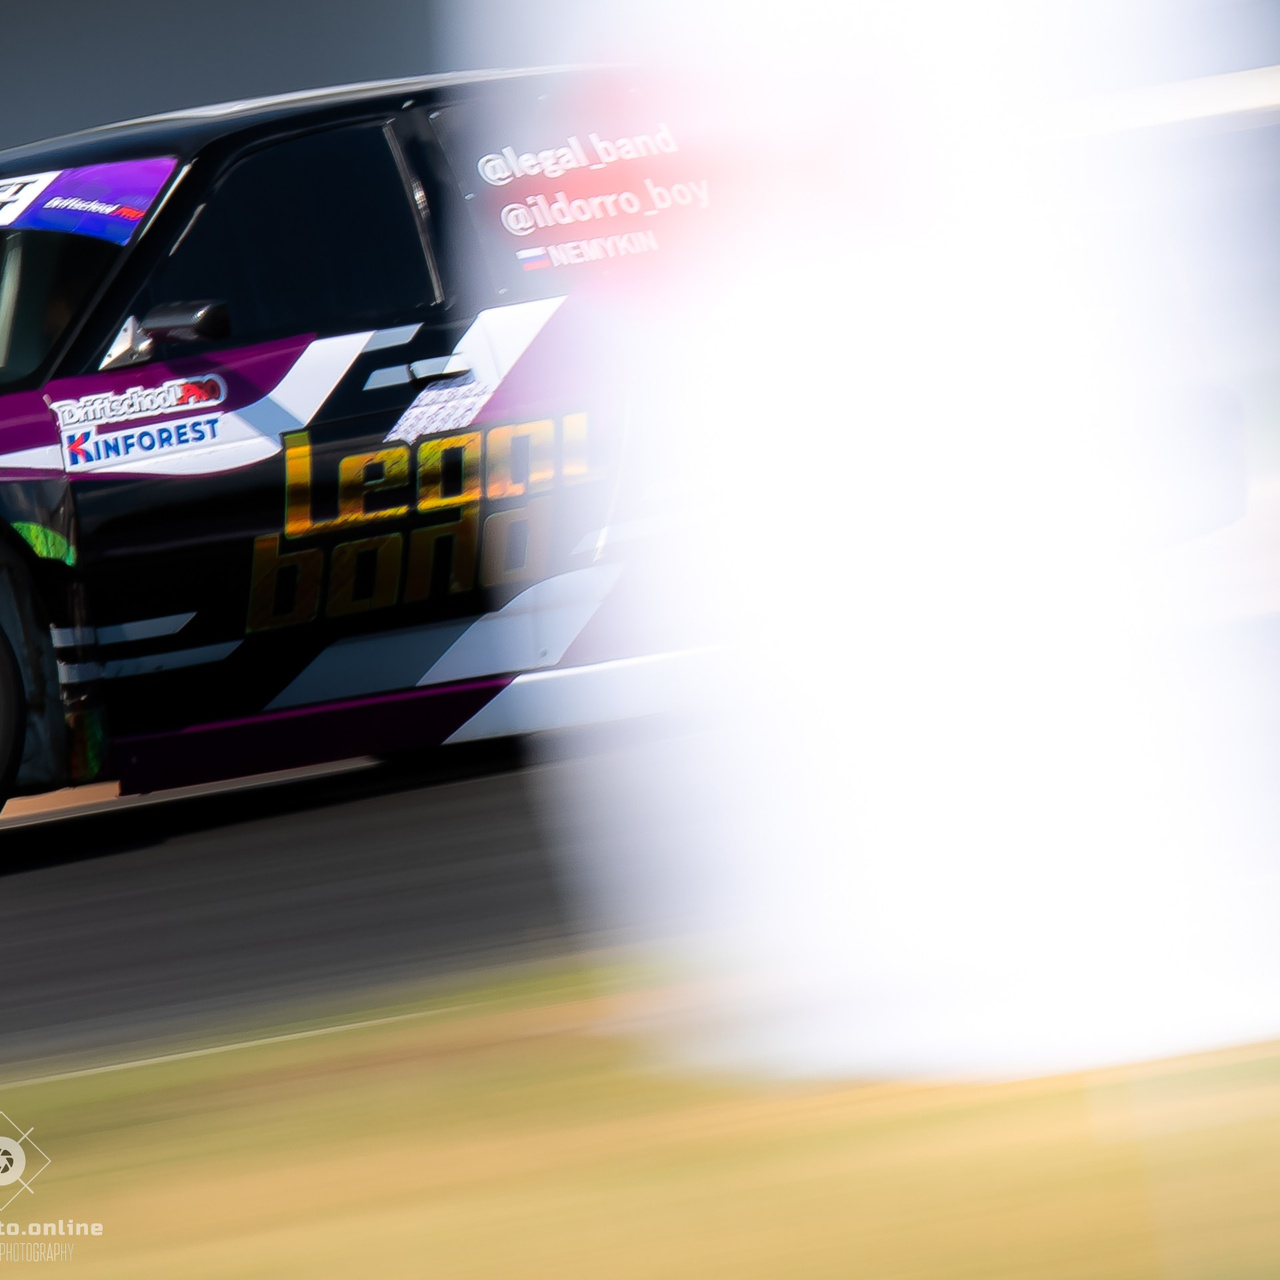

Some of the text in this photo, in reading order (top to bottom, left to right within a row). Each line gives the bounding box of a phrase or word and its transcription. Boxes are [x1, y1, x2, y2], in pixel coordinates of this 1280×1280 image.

[477, 123, 680, 186] @legal_band
[500, 178, 710, 236] @ildorro_boy
[547, 230, 659, 268] NEMYKIN
[67, 419, 219, 465] KINFOREST
